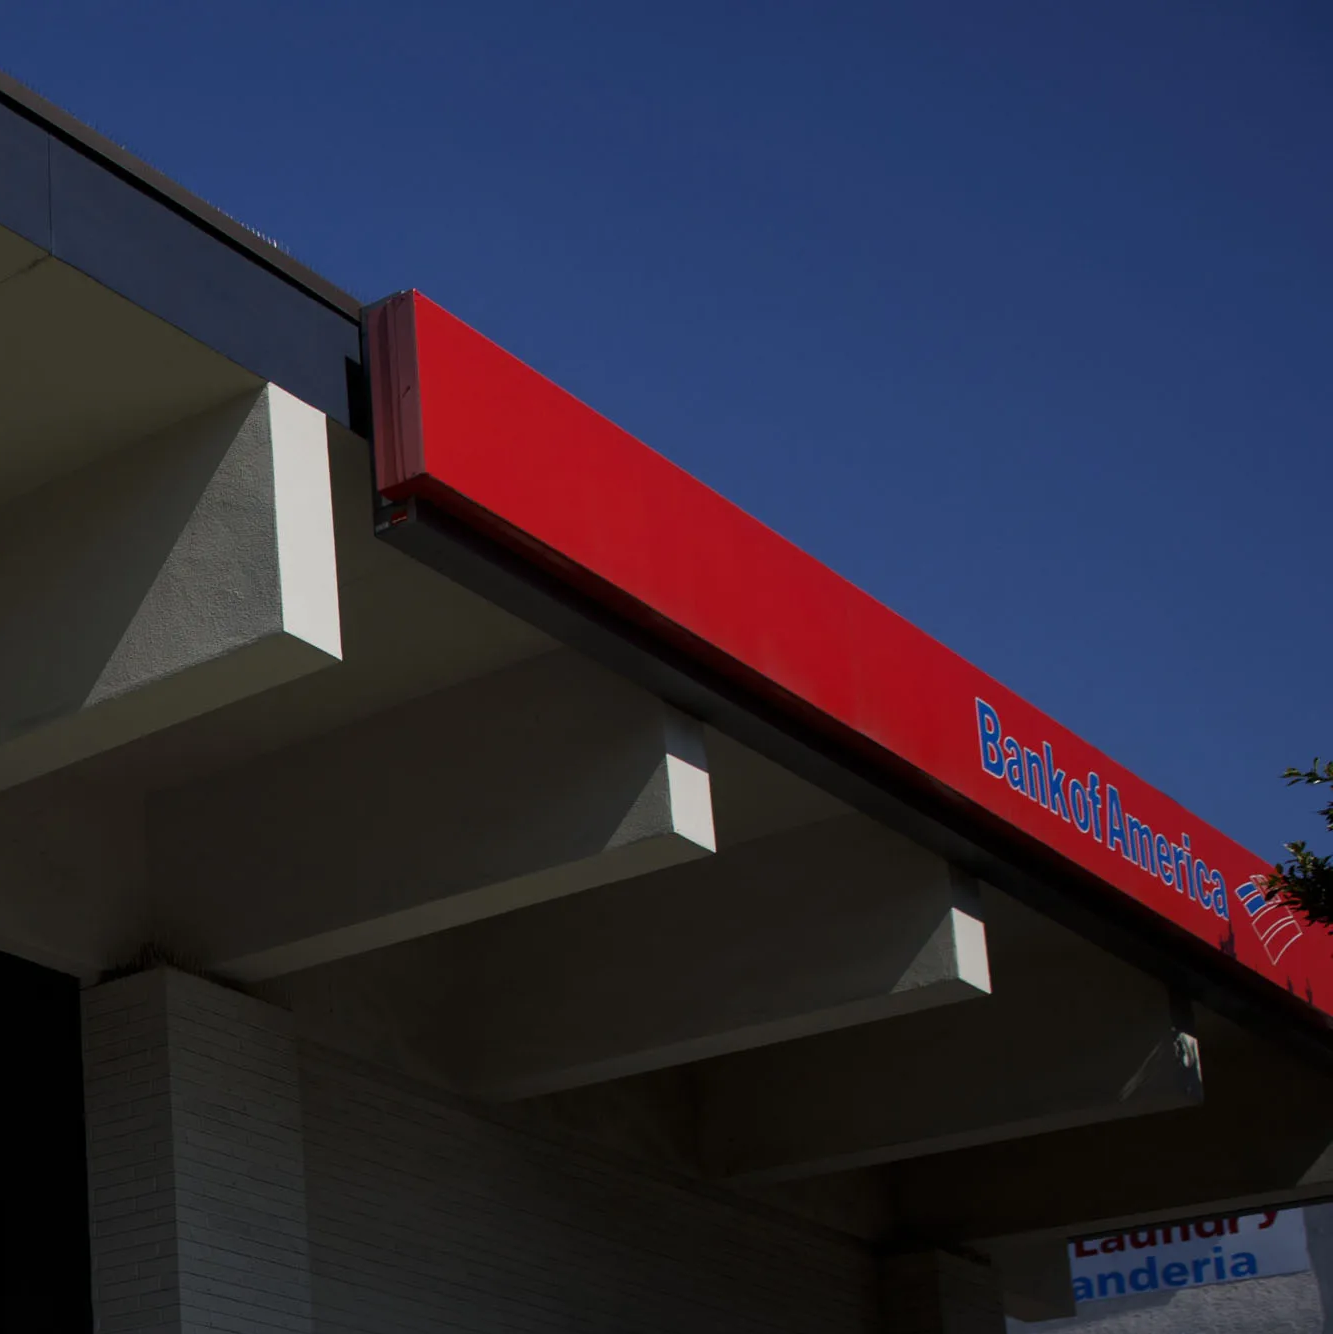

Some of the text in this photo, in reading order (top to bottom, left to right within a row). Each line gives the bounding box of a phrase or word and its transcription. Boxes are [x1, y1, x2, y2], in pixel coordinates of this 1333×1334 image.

[975, 697, 1229, 920] Bank of America
[1073, 1247, 1257, 1301] anderia
